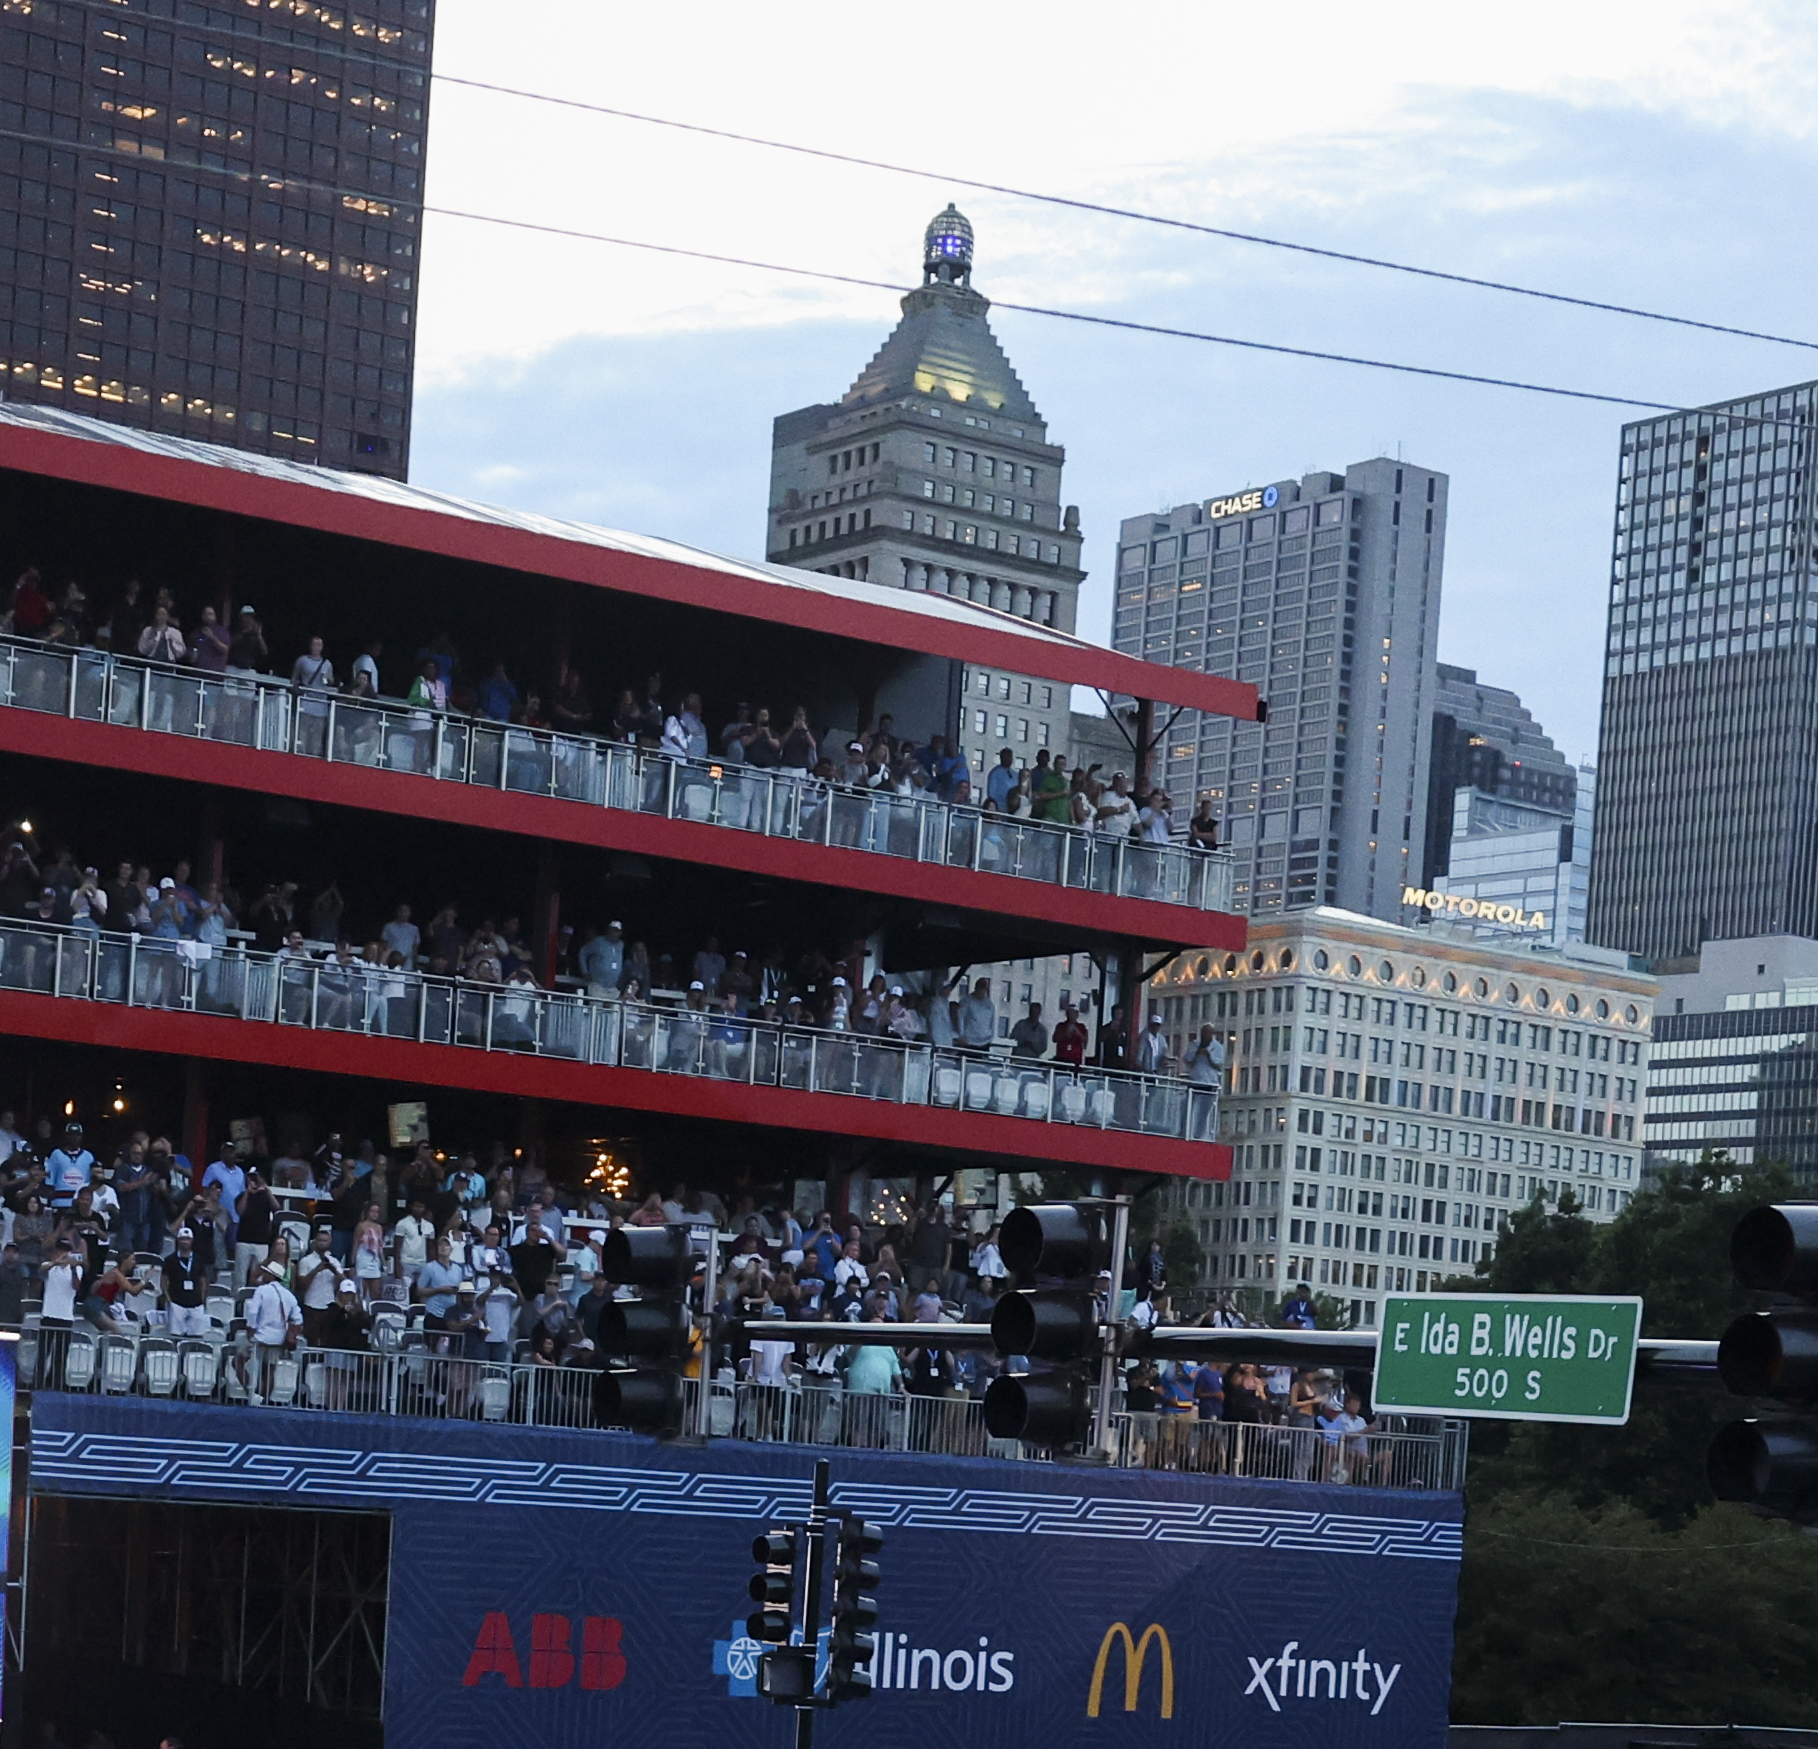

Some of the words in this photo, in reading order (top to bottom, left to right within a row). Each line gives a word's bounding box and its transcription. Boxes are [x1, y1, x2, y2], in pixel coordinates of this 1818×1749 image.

[1210, 490, 1264, 519] CHASE
[1402, 887, 1546, 930] MOTOROLA
[1394, 1323, 1411, 1352] E
[1420, 1312, 1460, 1356] Ida
[1470, 1313, 1496, 1358] B.
[1503, 1313, 1577, 1360] Wells
[1587, 1327, 1618, 1362] Dr
[1454, 1368, 1507, 1400] 500
[1525, 1371, 1542, 1401] S
[461, 1611, 627, 1691] ABB
[869, 1632, 1015, 1692] llinois
[1243, 1640, 1401, 1716] xfinity
